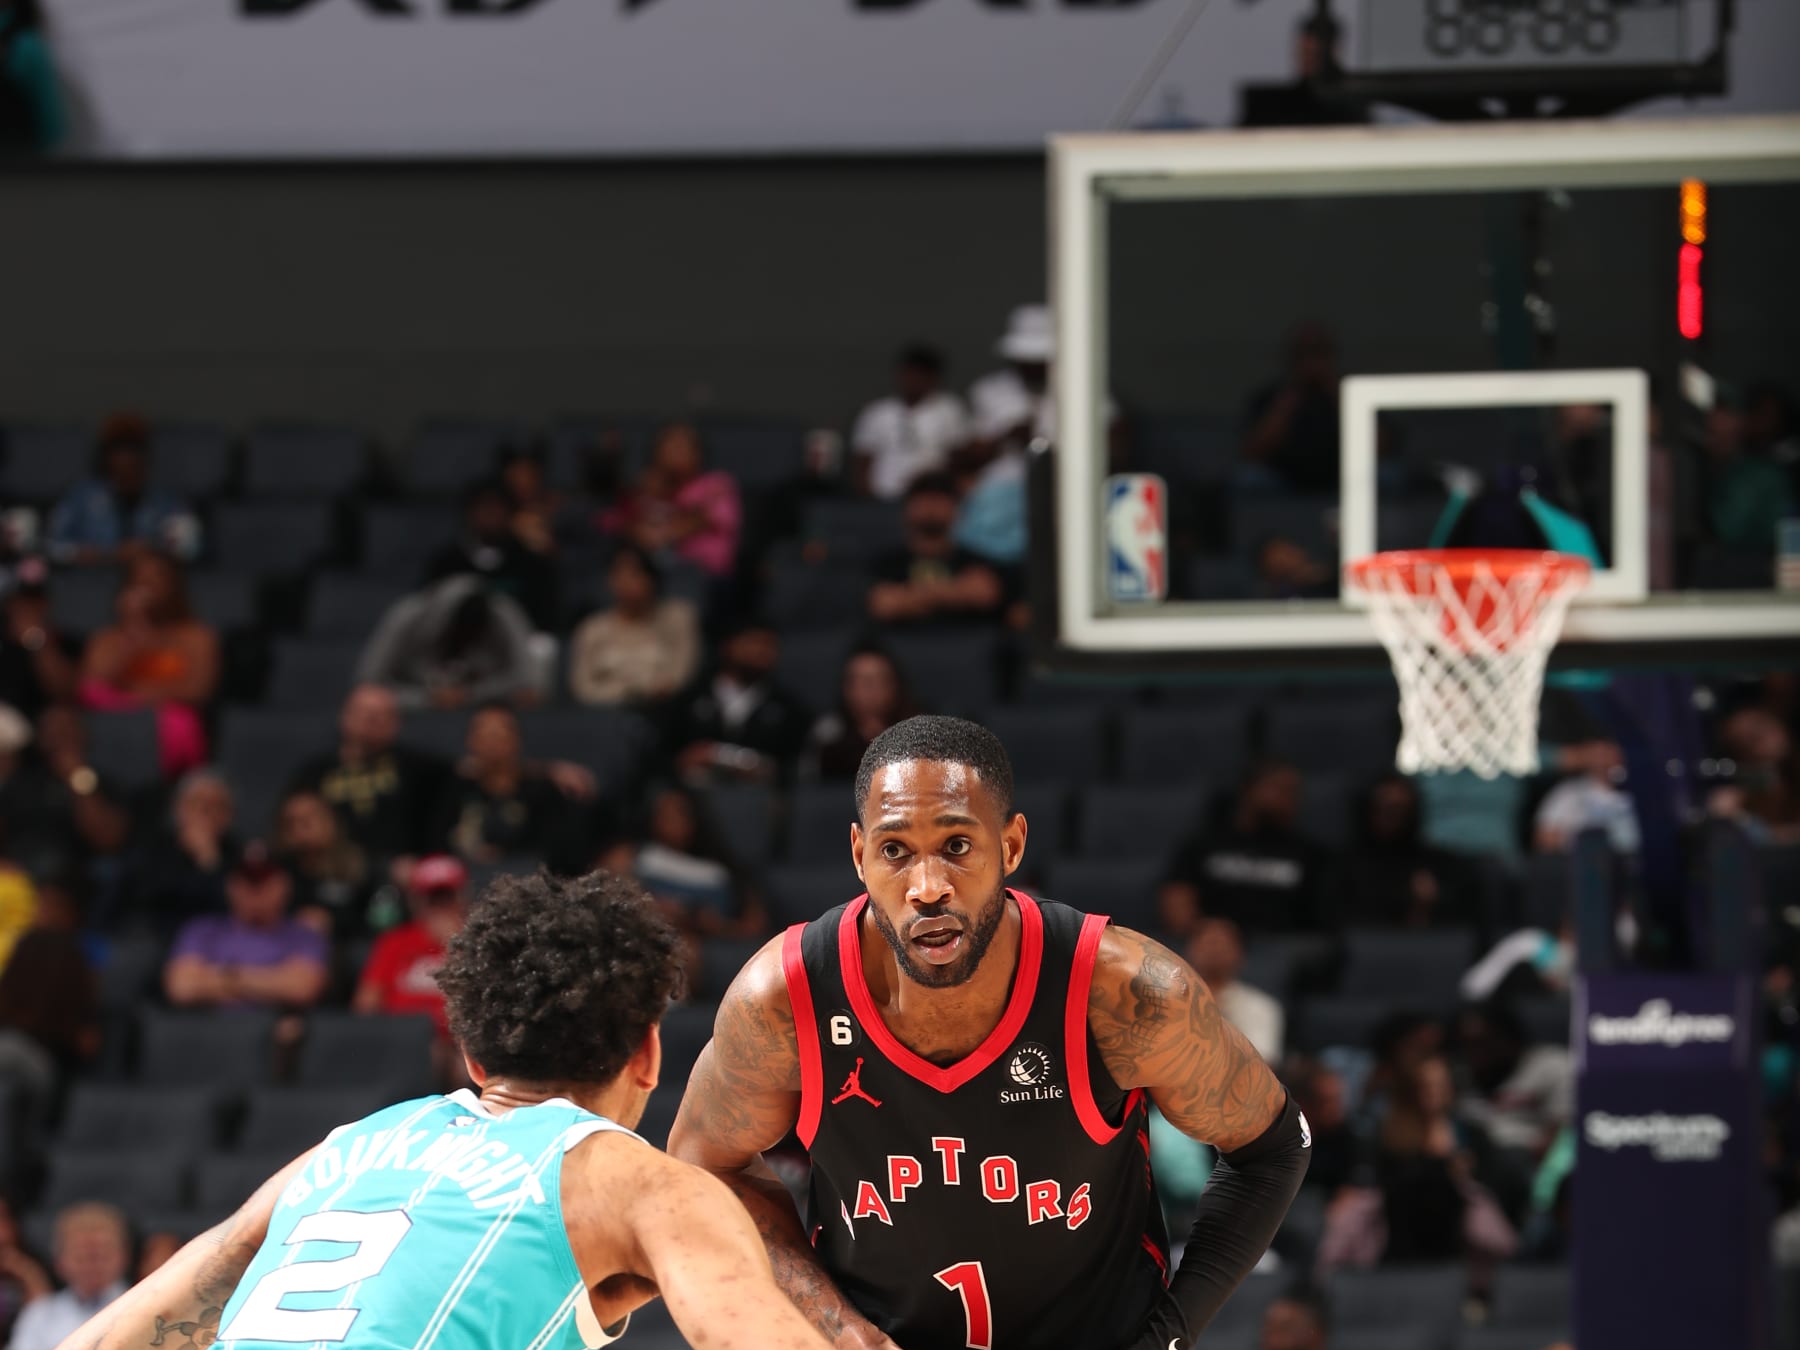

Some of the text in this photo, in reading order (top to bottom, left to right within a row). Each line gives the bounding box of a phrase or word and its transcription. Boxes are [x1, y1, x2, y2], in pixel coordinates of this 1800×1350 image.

[830, 1015, 853, 1046] 6
[1000, 1085, 1063, 1104] Sun Life
[279, 1129, 546, 1210] BOUKNIGHT
[841, 1136, 1092, 1240] APTORS
[217, 1208, 413, 1342] 2
[933, 1261, 993, 1350] 1
